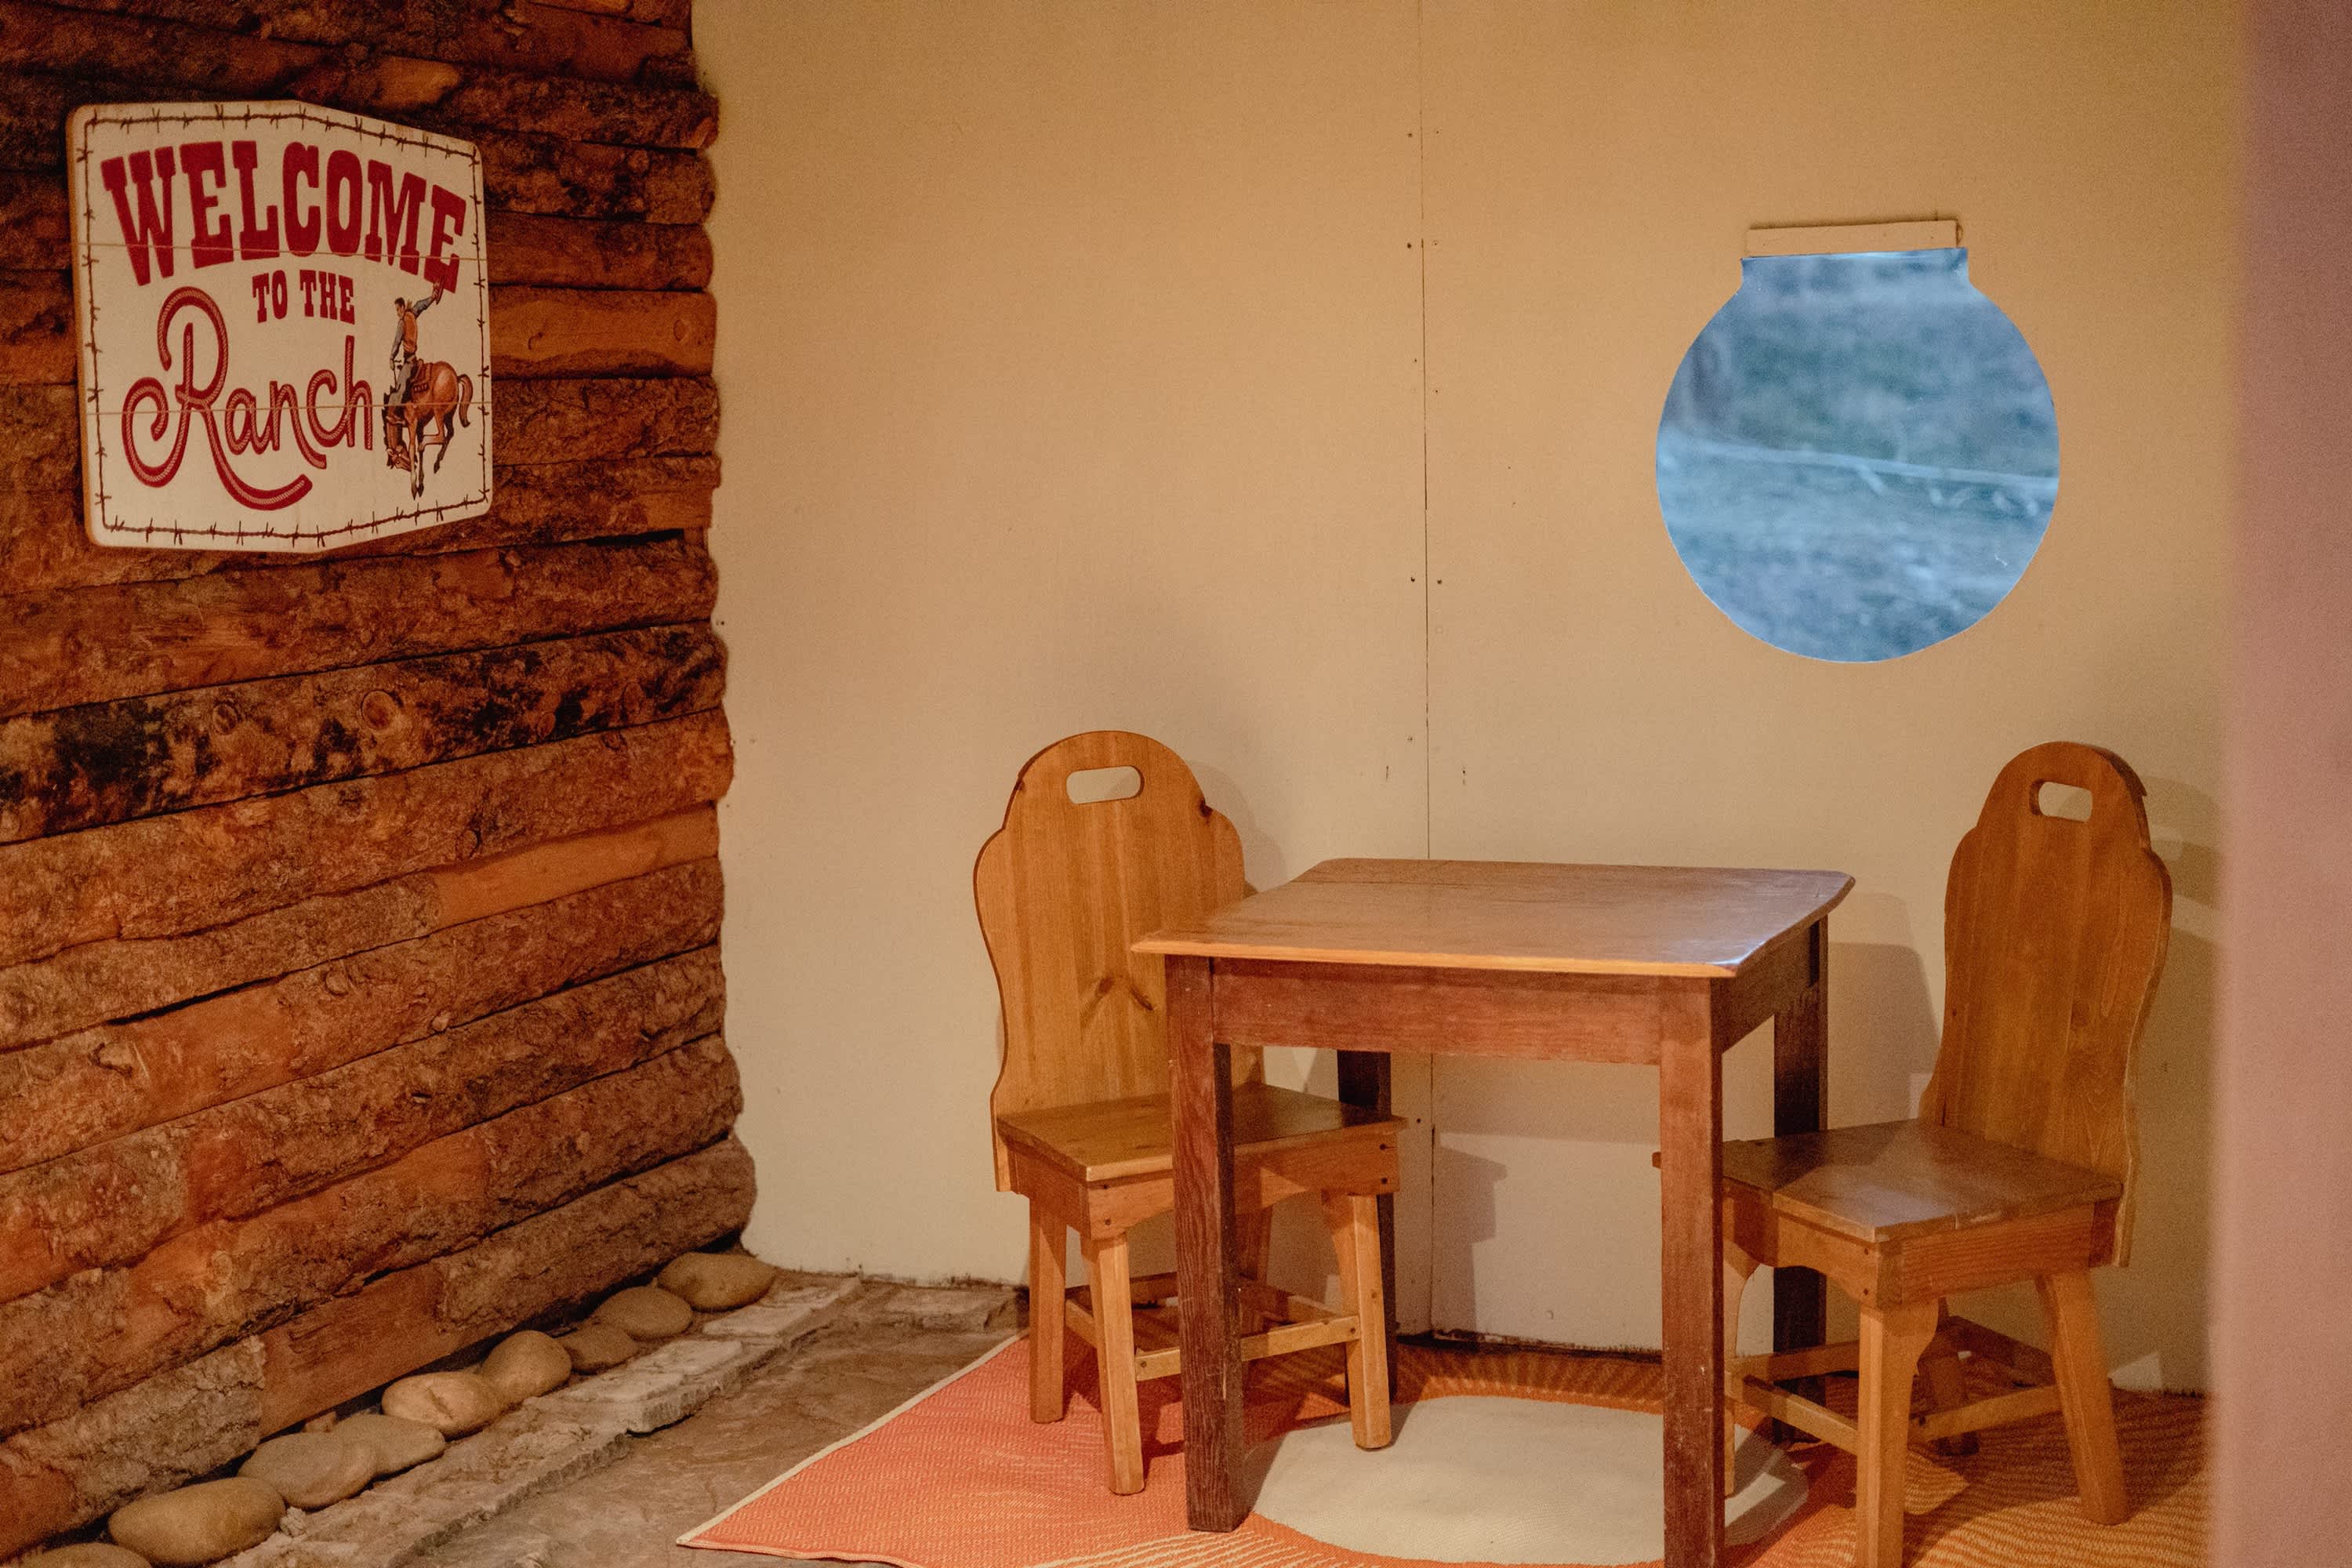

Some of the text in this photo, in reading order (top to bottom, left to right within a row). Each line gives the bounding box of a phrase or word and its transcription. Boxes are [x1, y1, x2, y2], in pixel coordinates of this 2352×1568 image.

[100, 140, 466, 294] WELCOME
[252, 269, 355, 325] TO THE
[122, 286, 373, 510] Ranch
